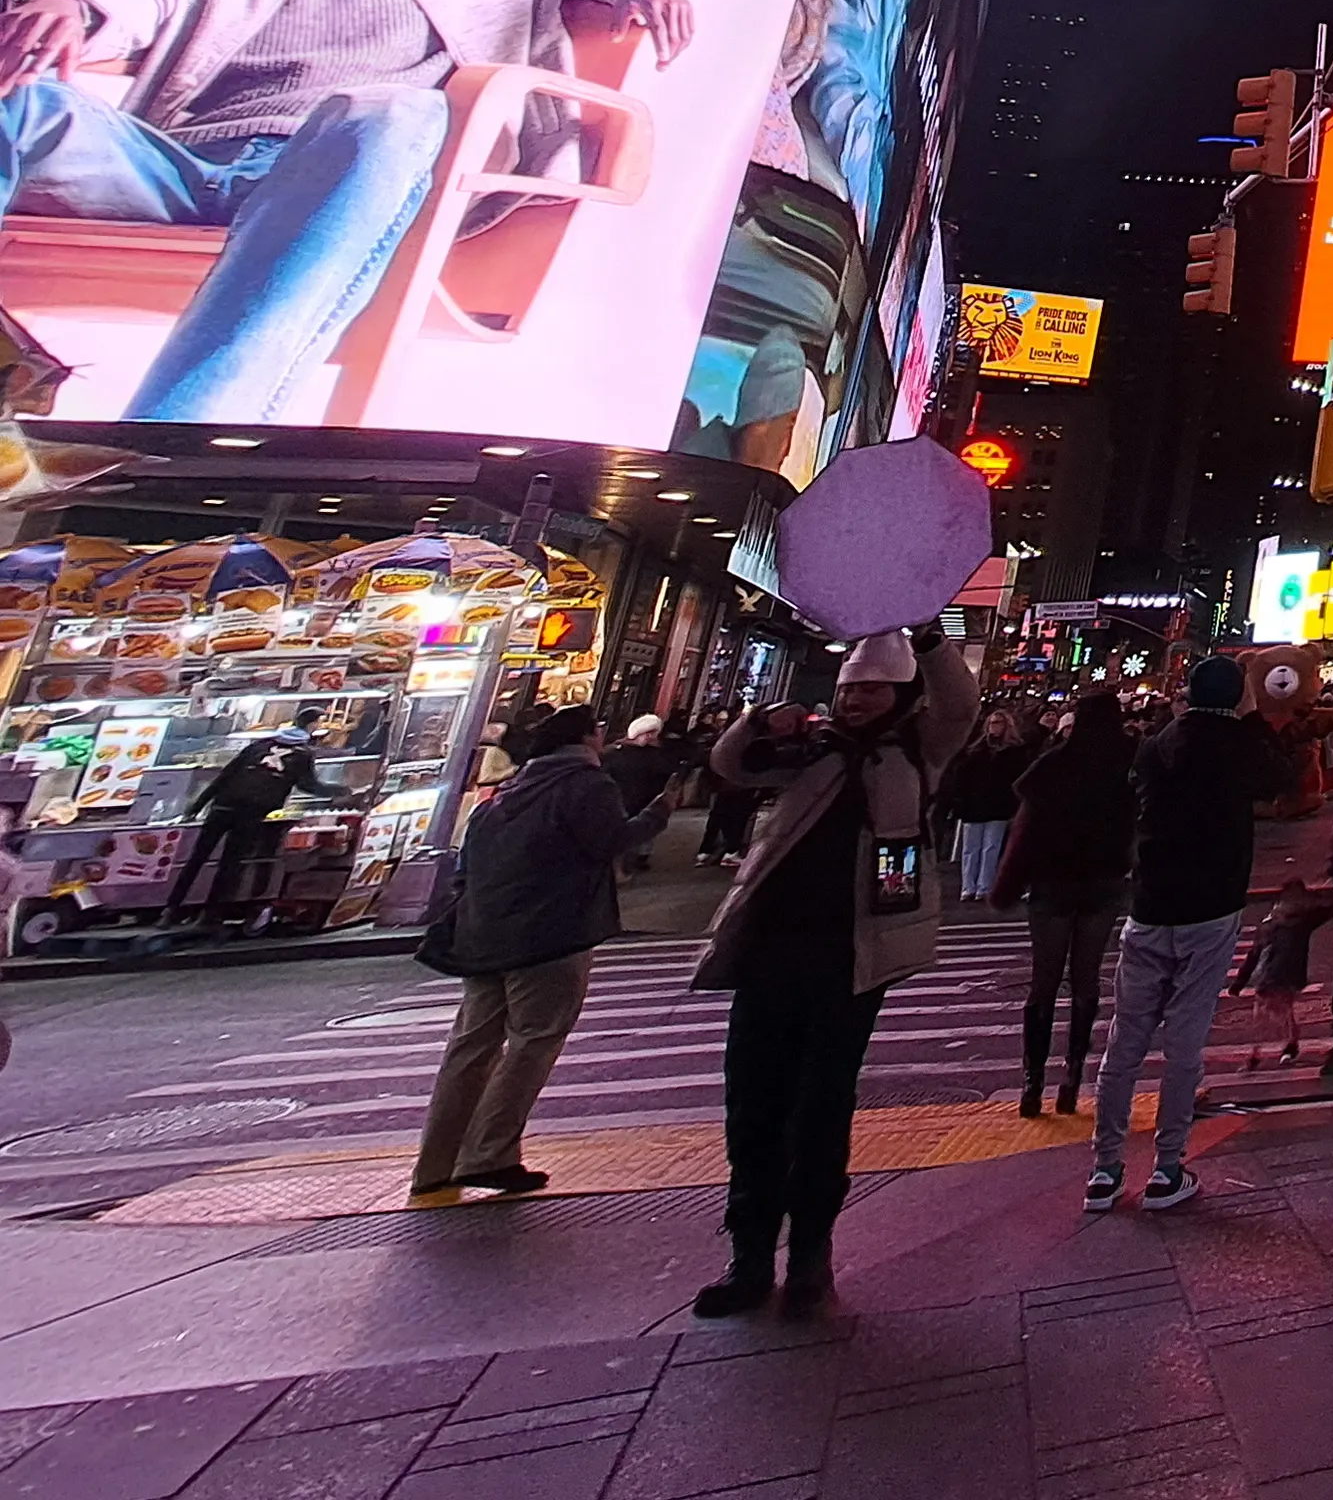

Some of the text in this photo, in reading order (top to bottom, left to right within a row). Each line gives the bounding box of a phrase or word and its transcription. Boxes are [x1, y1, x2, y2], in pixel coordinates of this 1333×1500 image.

[1038, 306, 1088, 322] PRIDE ROCK
[1043, 318, 1086, 336] CALLING
[1028, 346, 1080, 363] LION KING
